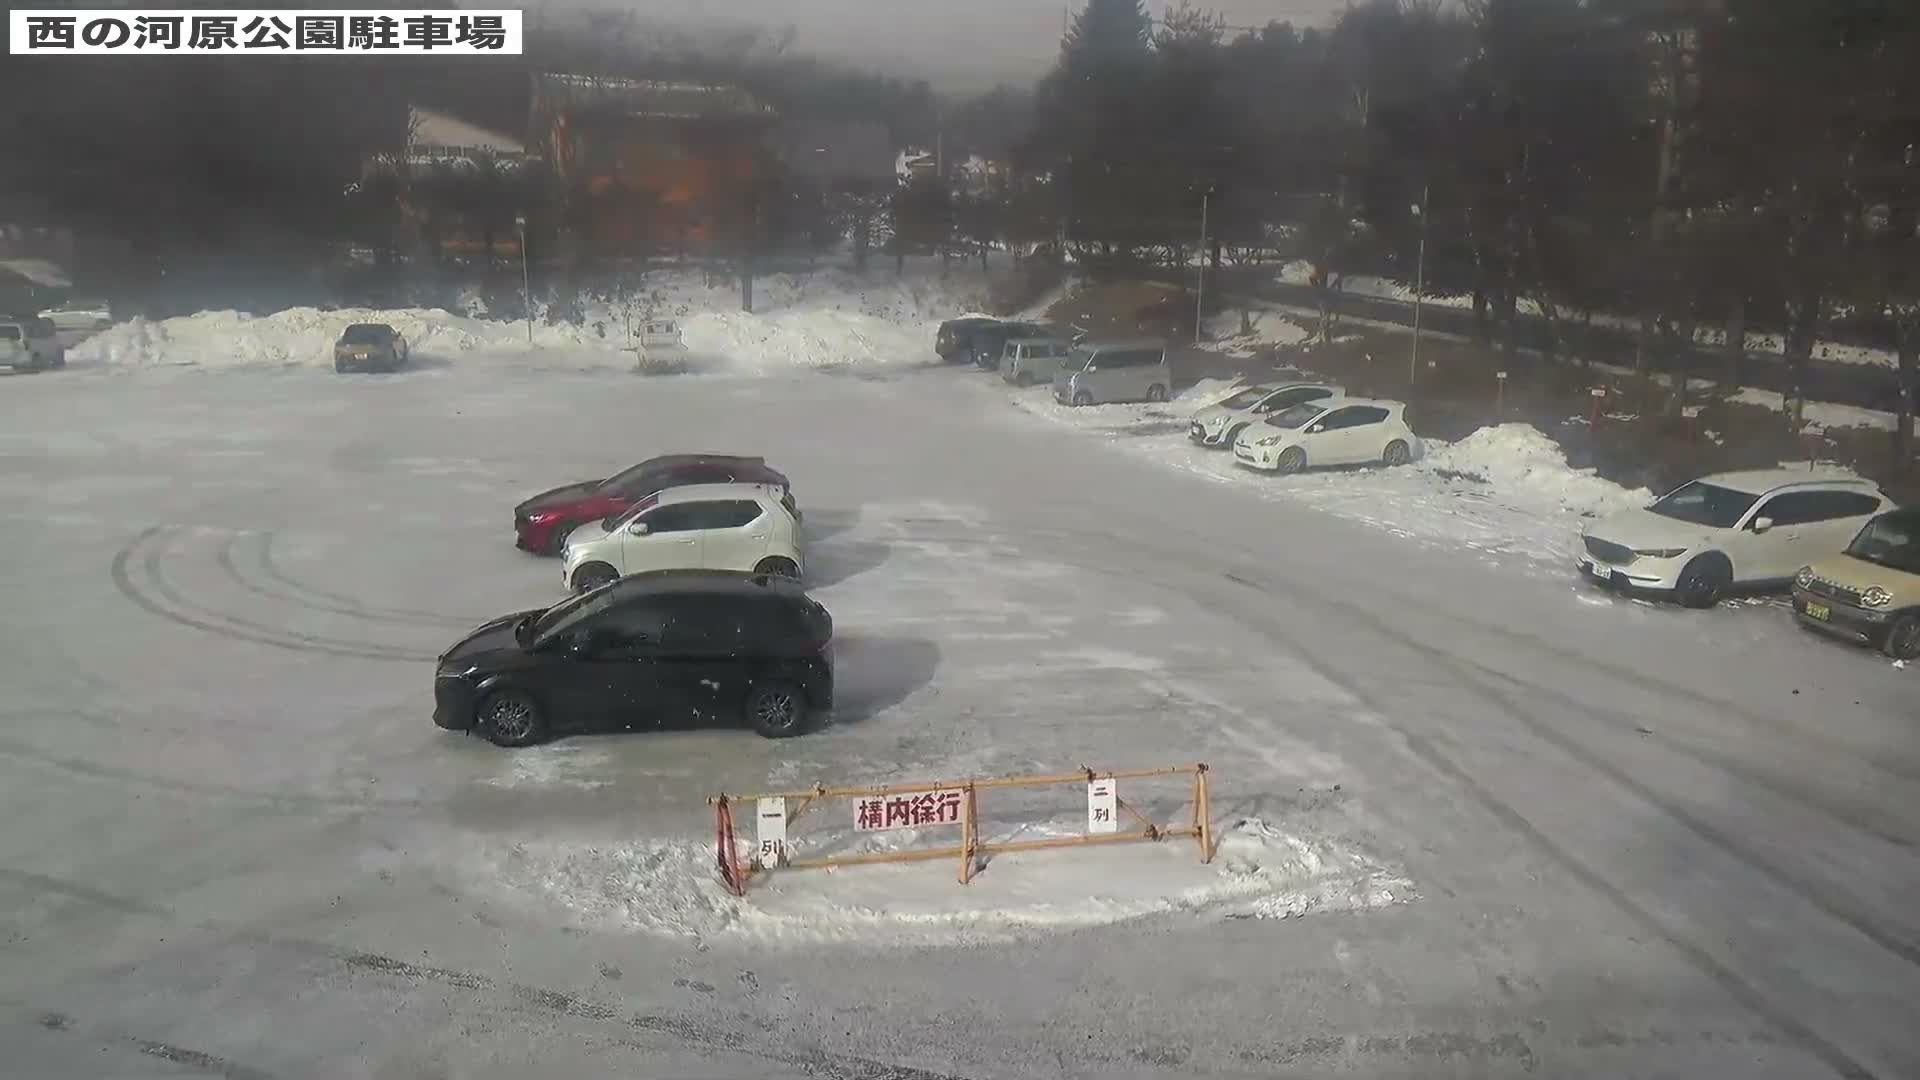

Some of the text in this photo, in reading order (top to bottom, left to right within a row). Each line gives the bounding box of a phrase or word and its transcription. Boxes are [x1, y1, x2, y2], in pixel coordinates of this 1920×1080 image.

[858, 792, 961, 829] 構内徐行
[1093, 786, 1109, 822] 二列
[761, 812, 783, 857] 一列
